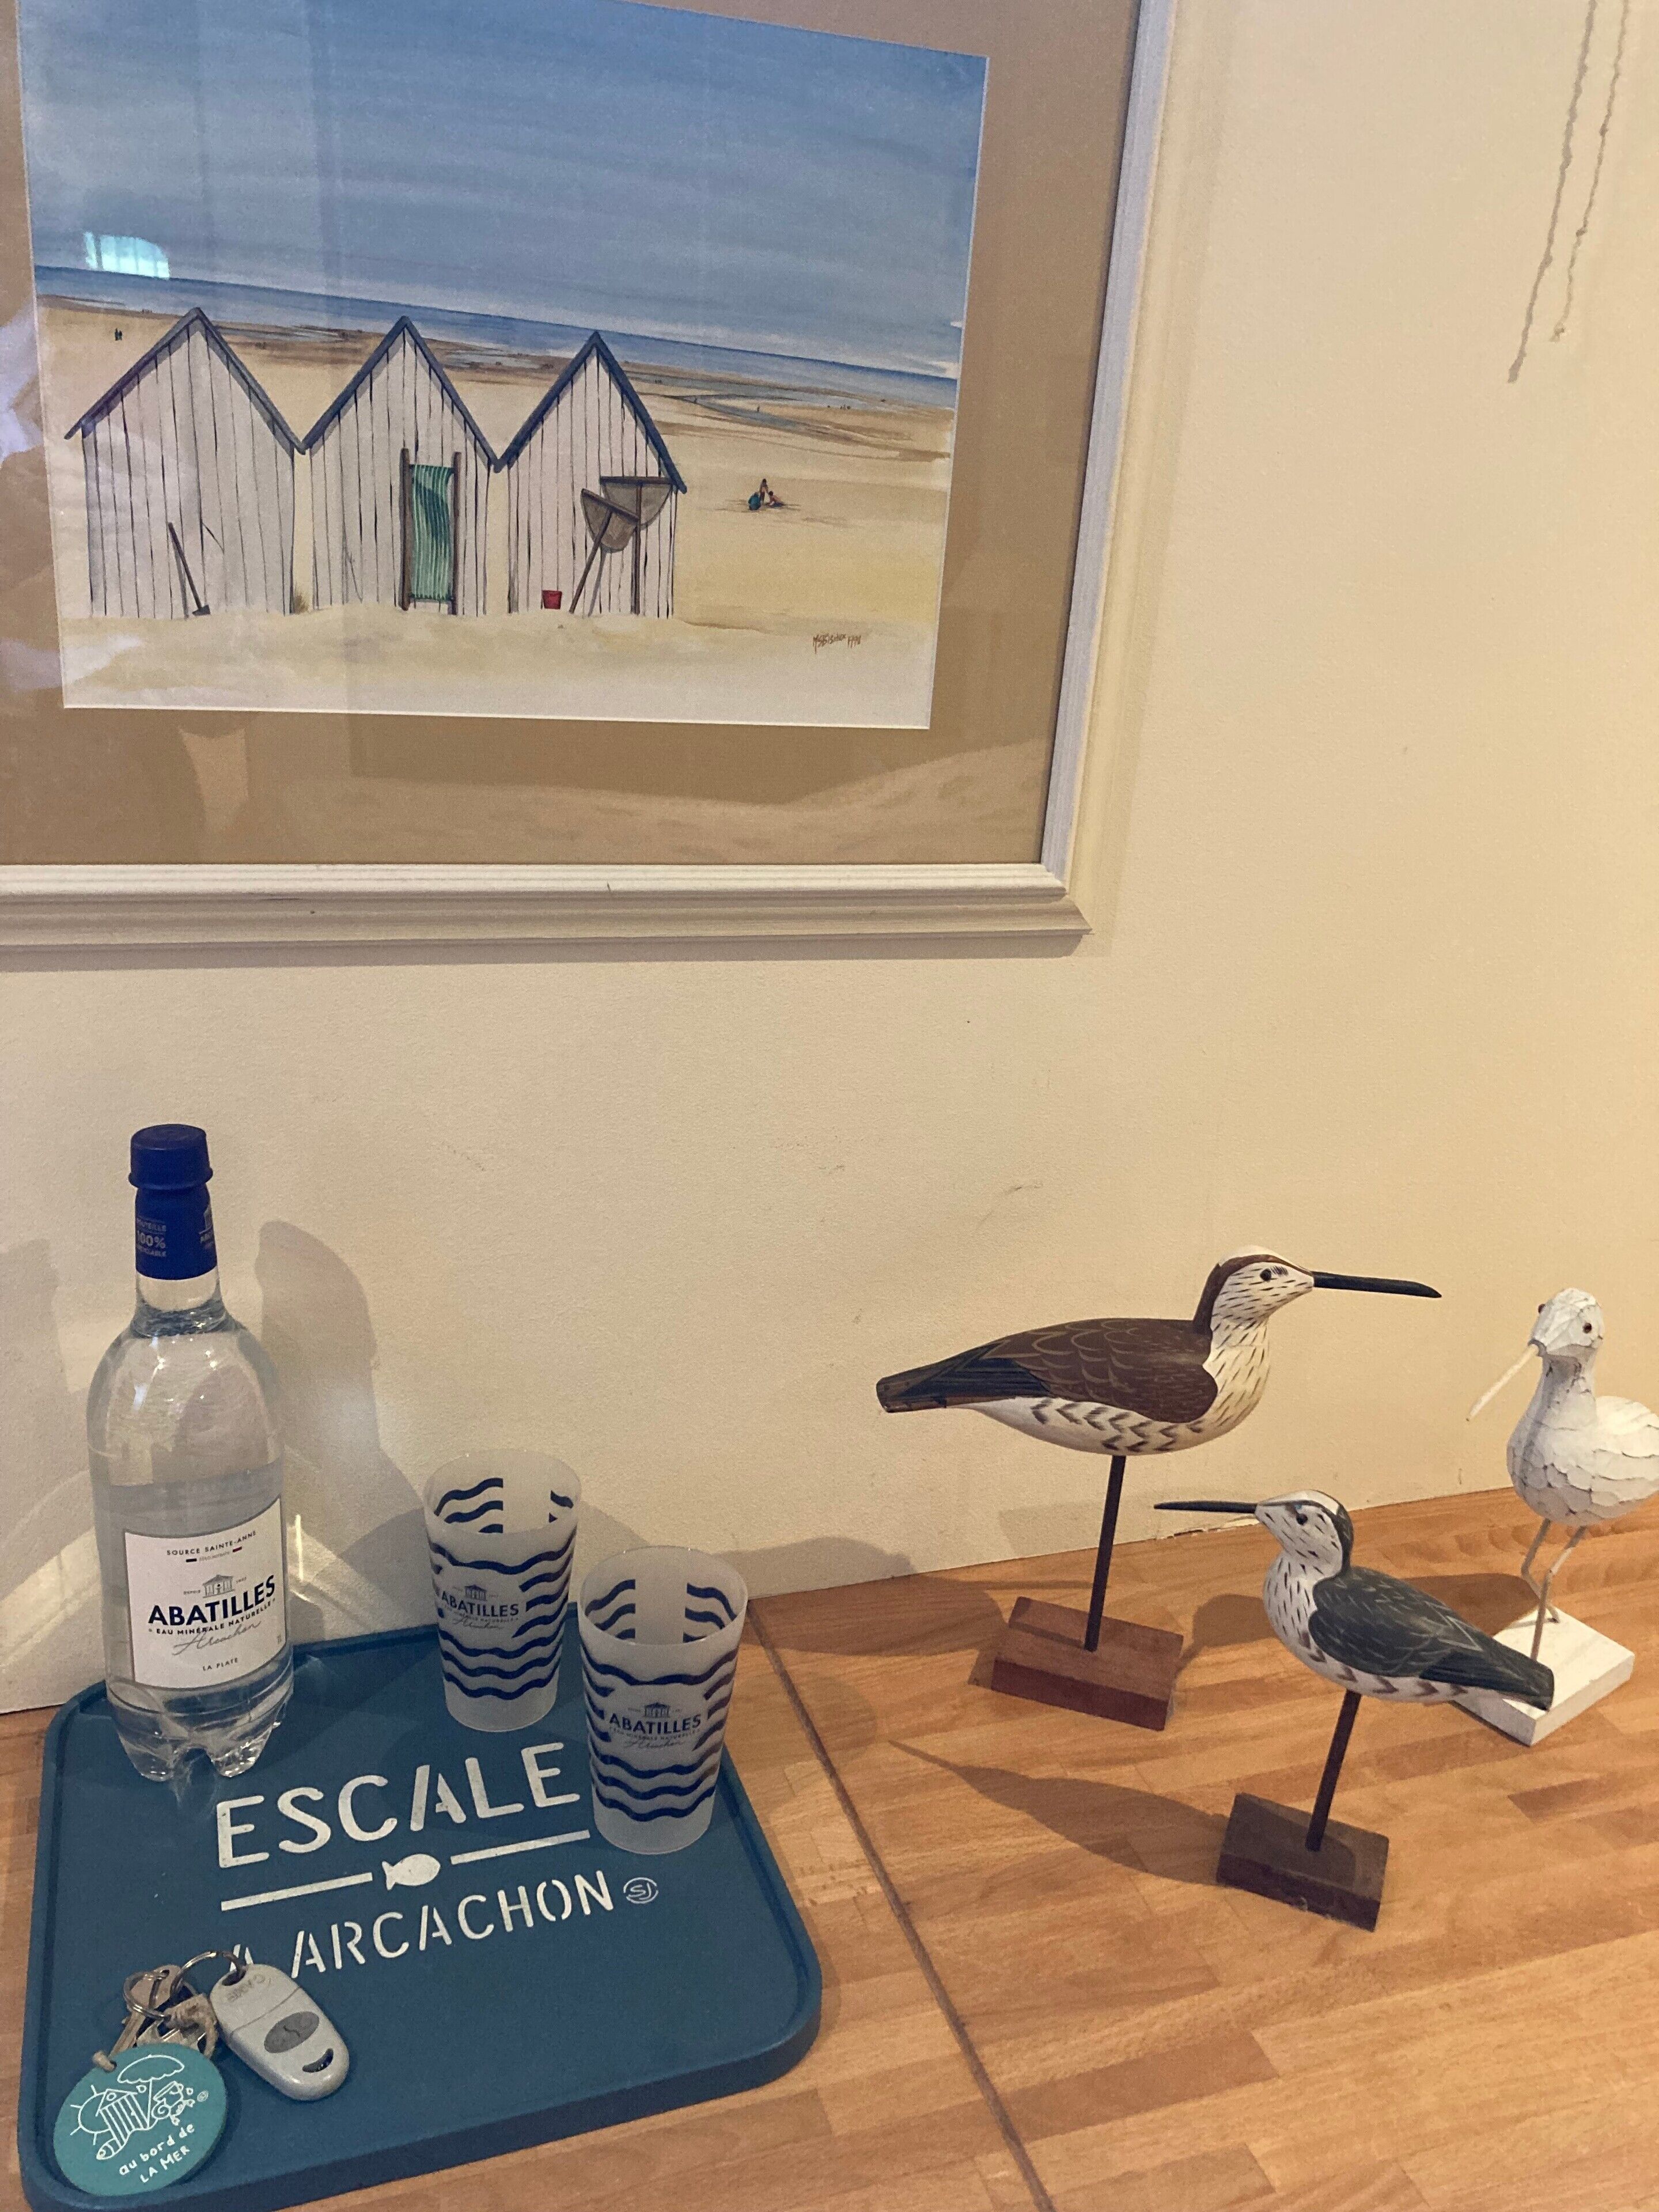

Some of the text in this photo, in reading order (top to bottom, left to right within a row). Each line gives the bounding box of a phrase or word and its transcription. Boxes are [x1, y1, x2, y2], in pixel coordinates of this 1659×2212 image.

[204, 1530, 256, 1552] SAINTE-ANNE
[148, 1574, 275, 1626] ABATILLES
[228, 1601, 271, 1627] NATURELLE
[442, 1590, 519, 1618] ABATILLES
[217, 1658, 238, 1668] PLATE
[609, 1713, 702, 1734] ABATILLES
[215, 1742, 581, 1868] ESCALE
[290, 1870, 614, 1978] ARCACHON
[119, 2123, 195, 2176] au bord de
[140, 2145, 190, 2183] LA MER
